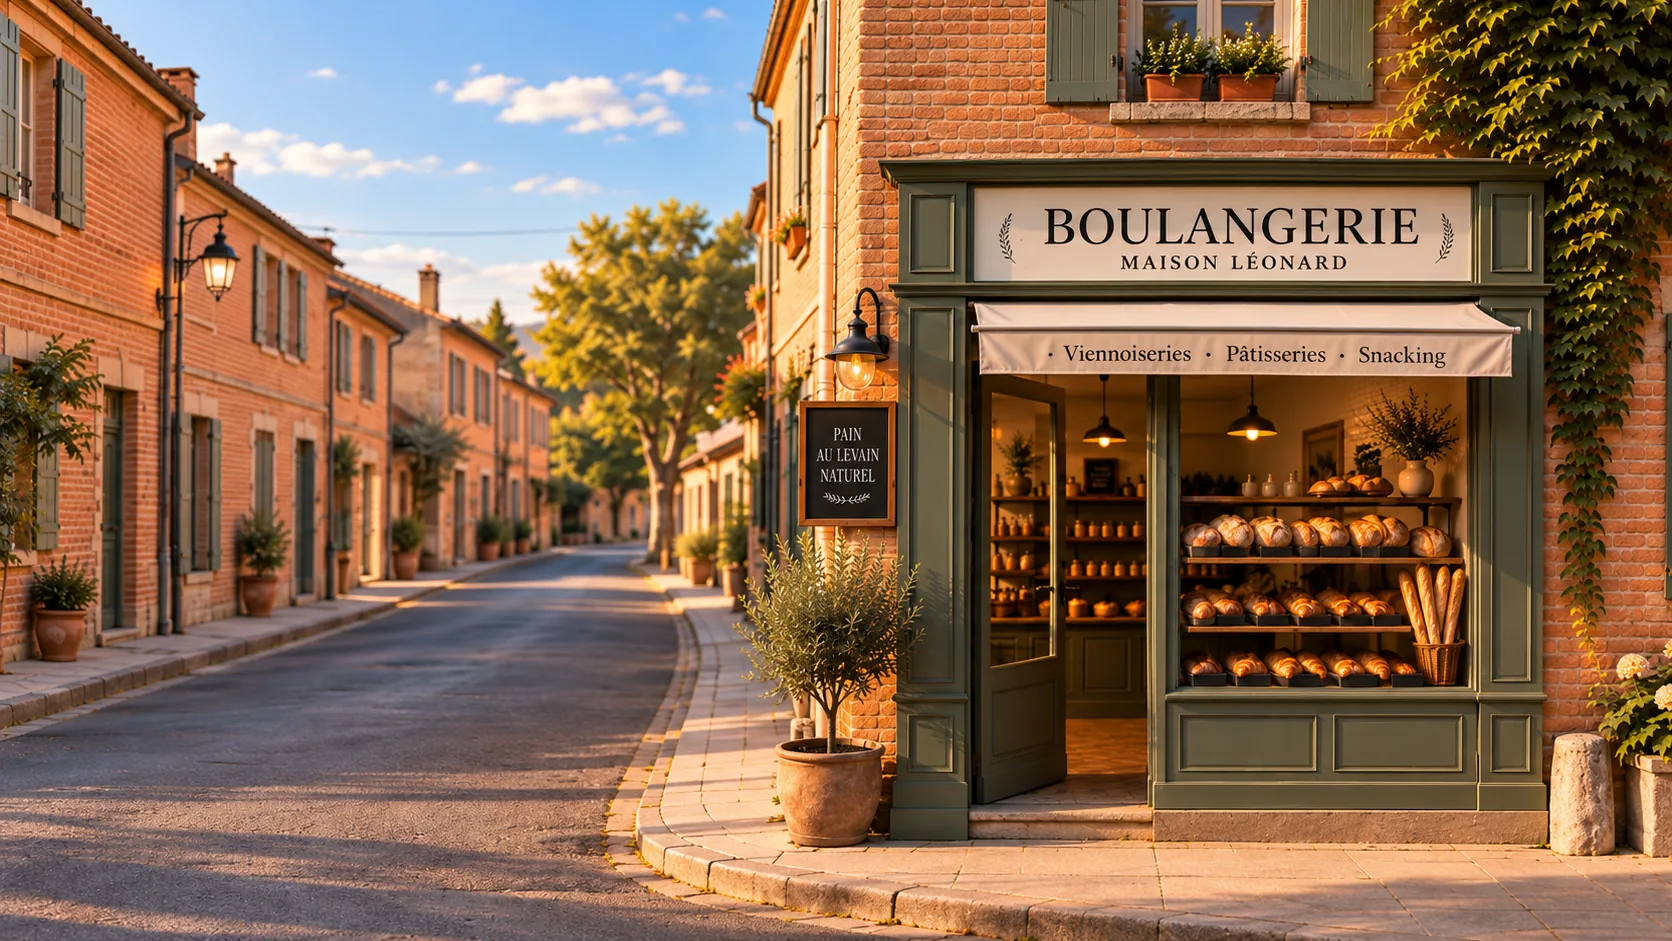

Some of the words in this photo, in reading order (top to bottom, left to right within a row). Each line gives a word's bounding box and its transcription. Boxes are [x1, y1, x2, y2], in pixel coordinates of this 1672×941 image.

[1044, 207, 1419, 245] BOULANGERIE
[1120, 254, 1218, 271] MAISON
[1231, 251, 1347, 271] LÉONARD
[1063, 344, 1192, 362] Viennoiseries
[1226, 345, 1326, 363] Pâtisseries
[1358, 345, 1447, 368] Snacking
[833, 427, 862, 441] PAIN
[816, 448, 833, 462] AU
[837, 448, 879, 462] LEVAIN
[820, 468, 876, 483] NATUREL
